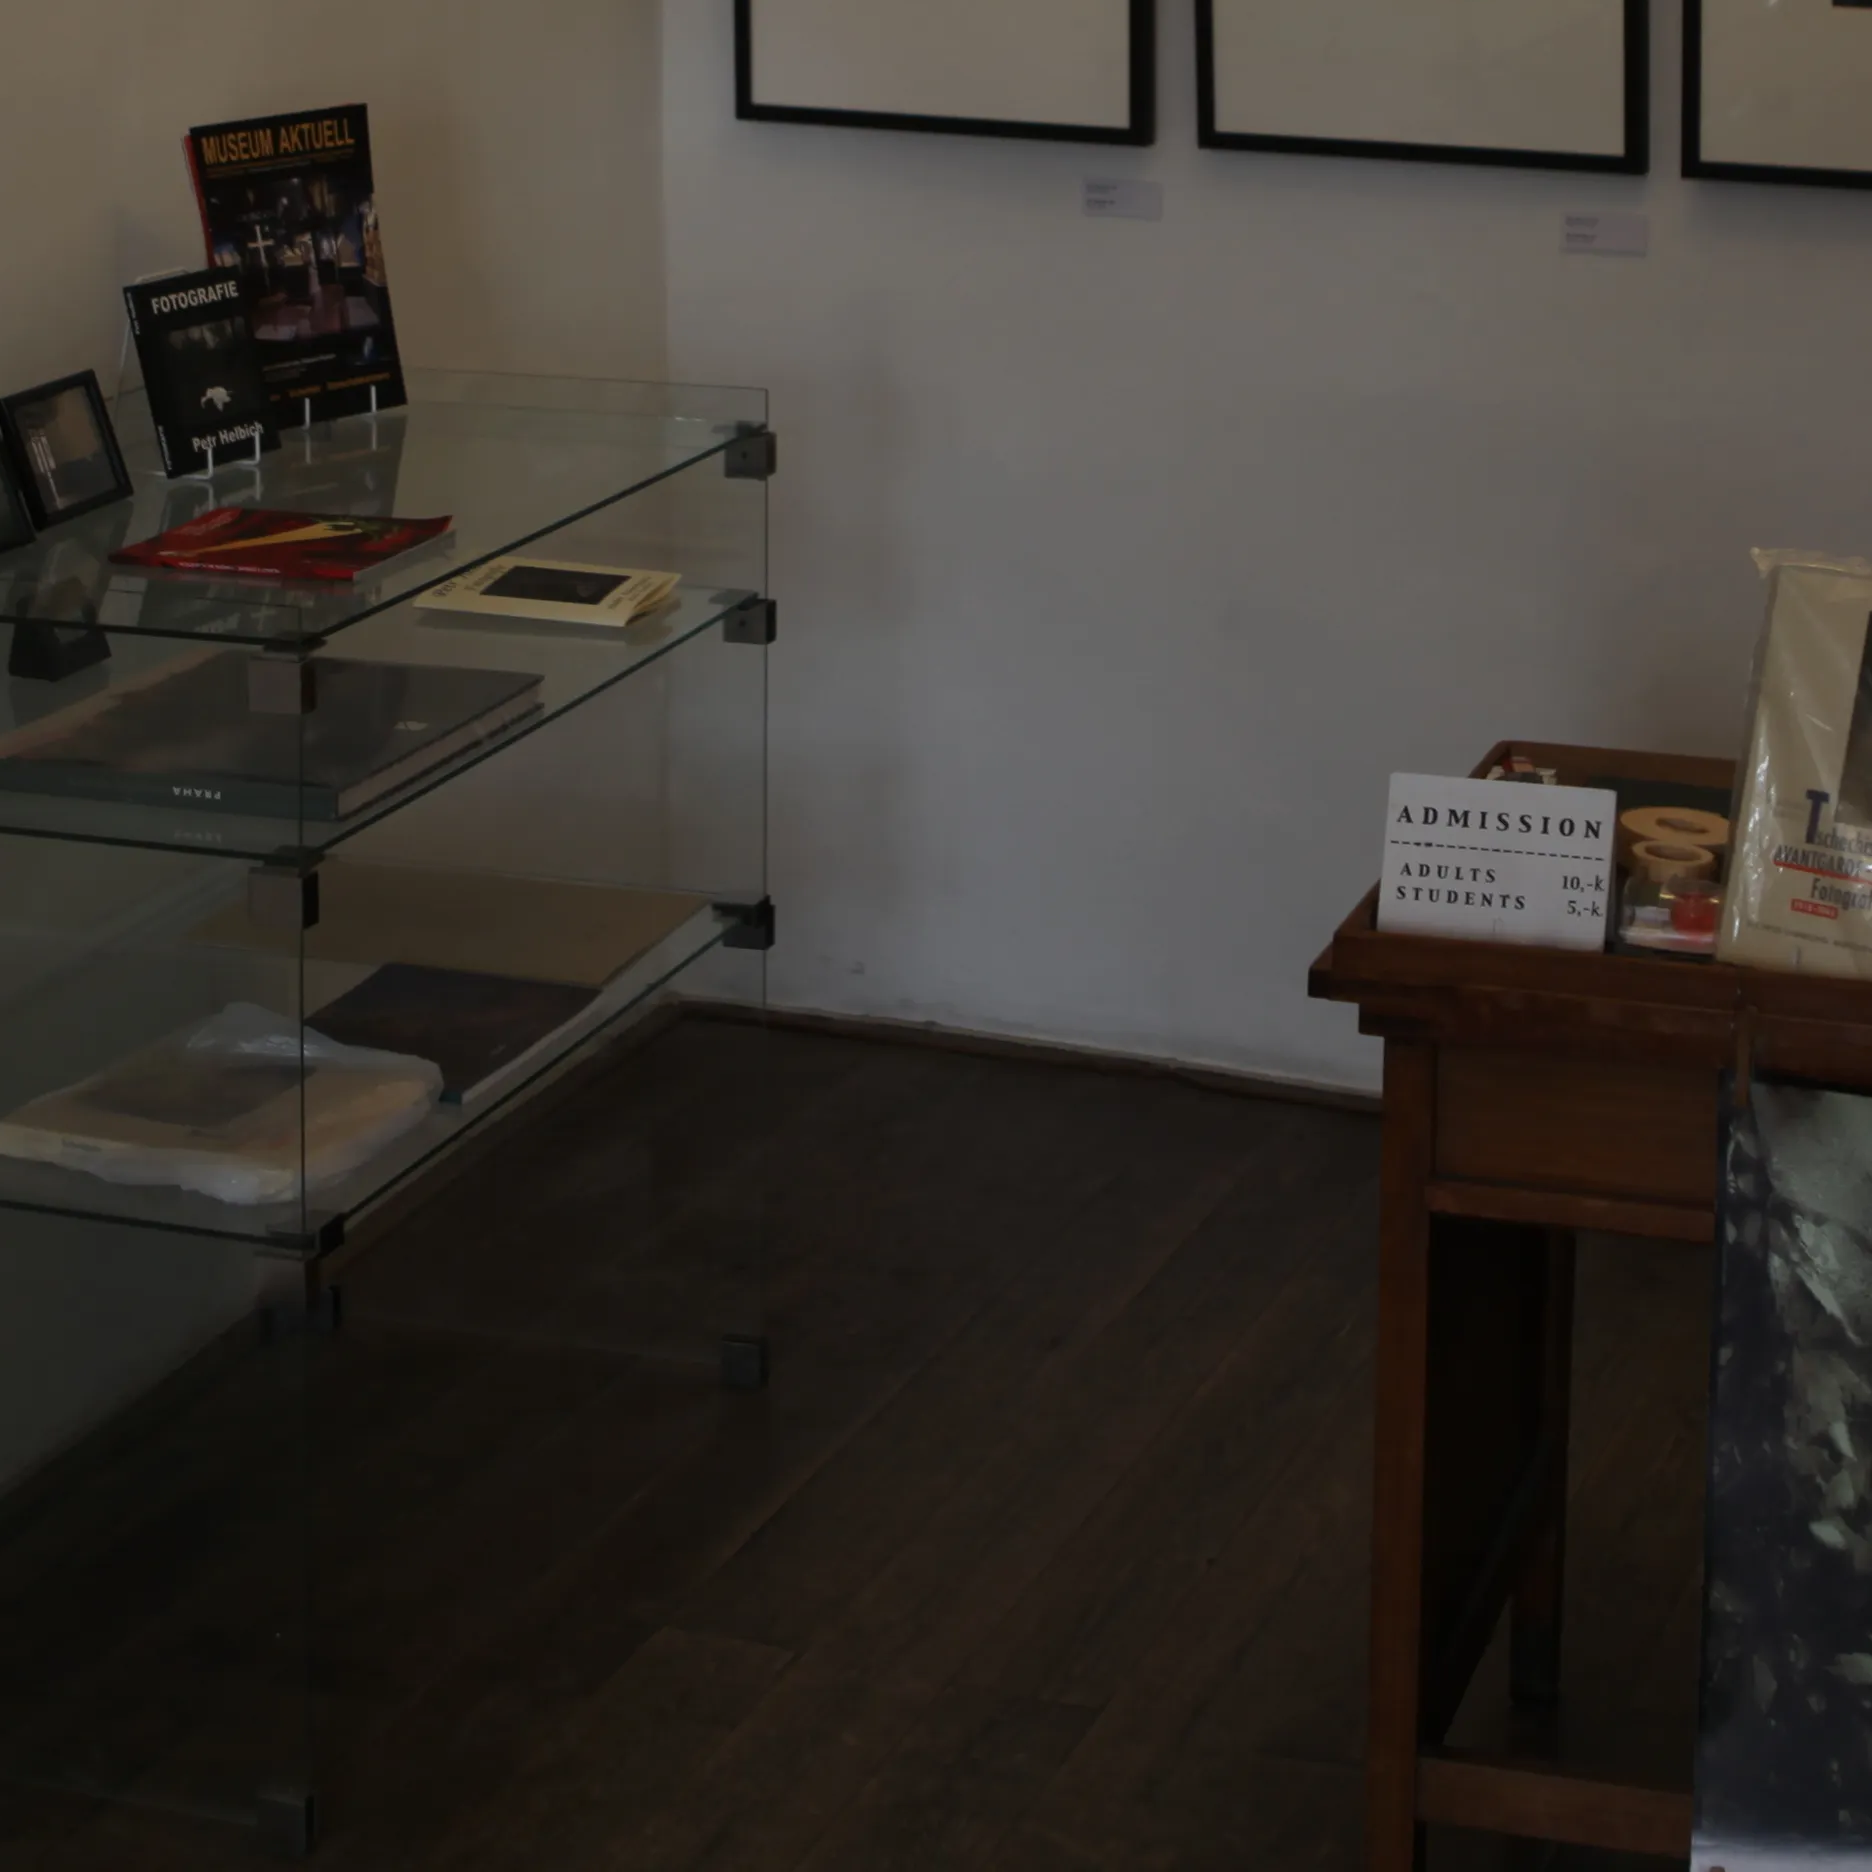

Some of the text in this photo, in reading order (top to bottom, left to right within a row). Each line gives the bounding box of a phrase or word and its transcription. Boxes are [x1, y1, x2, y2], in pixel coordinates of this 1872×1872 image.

[200, 128, 275, 165] MUSEUM
[279, 118, 356, 154] AKTUELL
[151, 280, 239, 315] FOTOGRAFIE
[191, 433, 218, 453] Petr
[219, 419, 265, 445] Helbich
[172, 785, 221, 800] PRAHA
[1397, 805, 1603, 839] ADMISSION
[1399, 862, 1497, 884] ADULTS
[1396, 885, 1527, 911] STUDENTS
